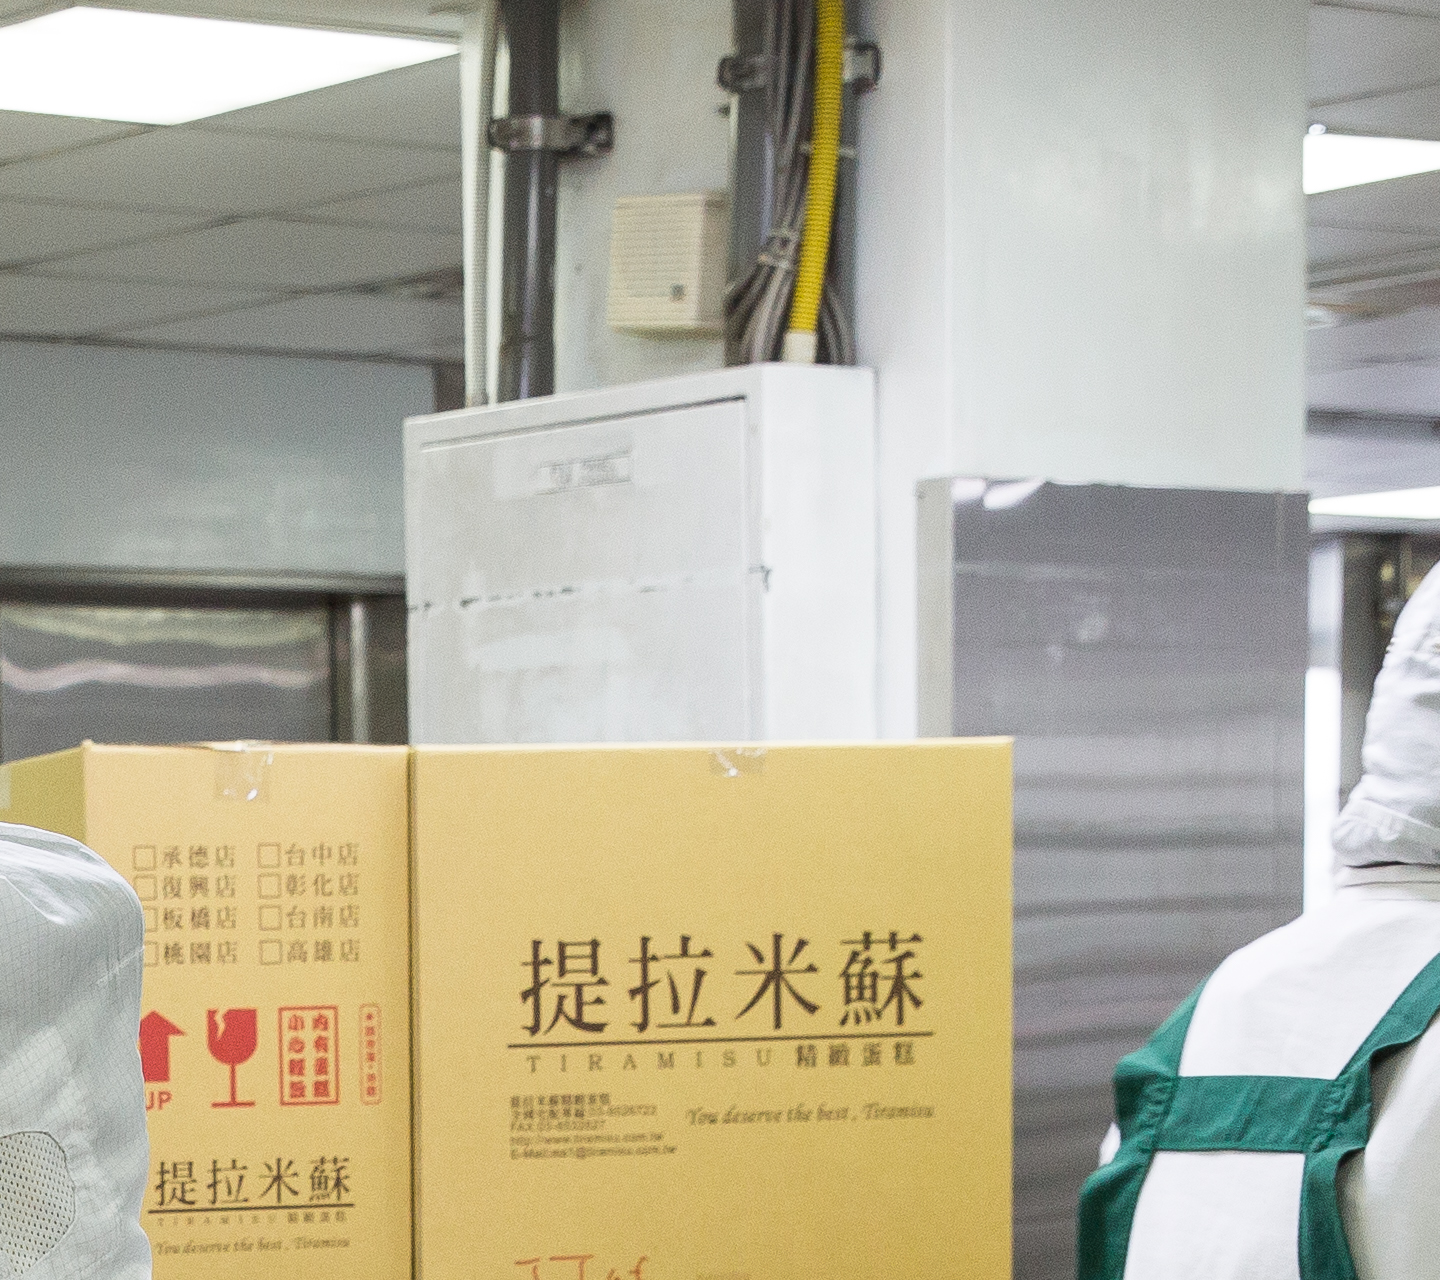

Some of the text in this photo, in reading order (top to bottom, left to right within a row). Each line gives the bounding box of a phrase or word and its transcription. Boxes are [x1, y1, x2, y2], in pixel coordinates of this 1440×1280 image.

[163, 844, 236, 868] 承德店
[285, 842, 359, 866] 台中店
[163, 875, 236, 899] 復興店
[285, 872, 360, 896] 彰化店
[163, 905, 237, 930] 板橋店
[286, 904, 360, 928] 台南店
[164, 940, 238, 965] 桃園店
[287, 938, 360, 963] 高雄店
[520, 931, 924, 1036] 提拉米蘇
[526, 1049, 772, 1074] TIRAMISU
[686, 1107, 719, 1126] You
[722, 1103, 784, 1124] deserve
[786, 1102, 814, 1123] the
[862, 1102, 935, 1120] Tiramisu
[155, 1156, 350, 1206] 提拉米蘇
